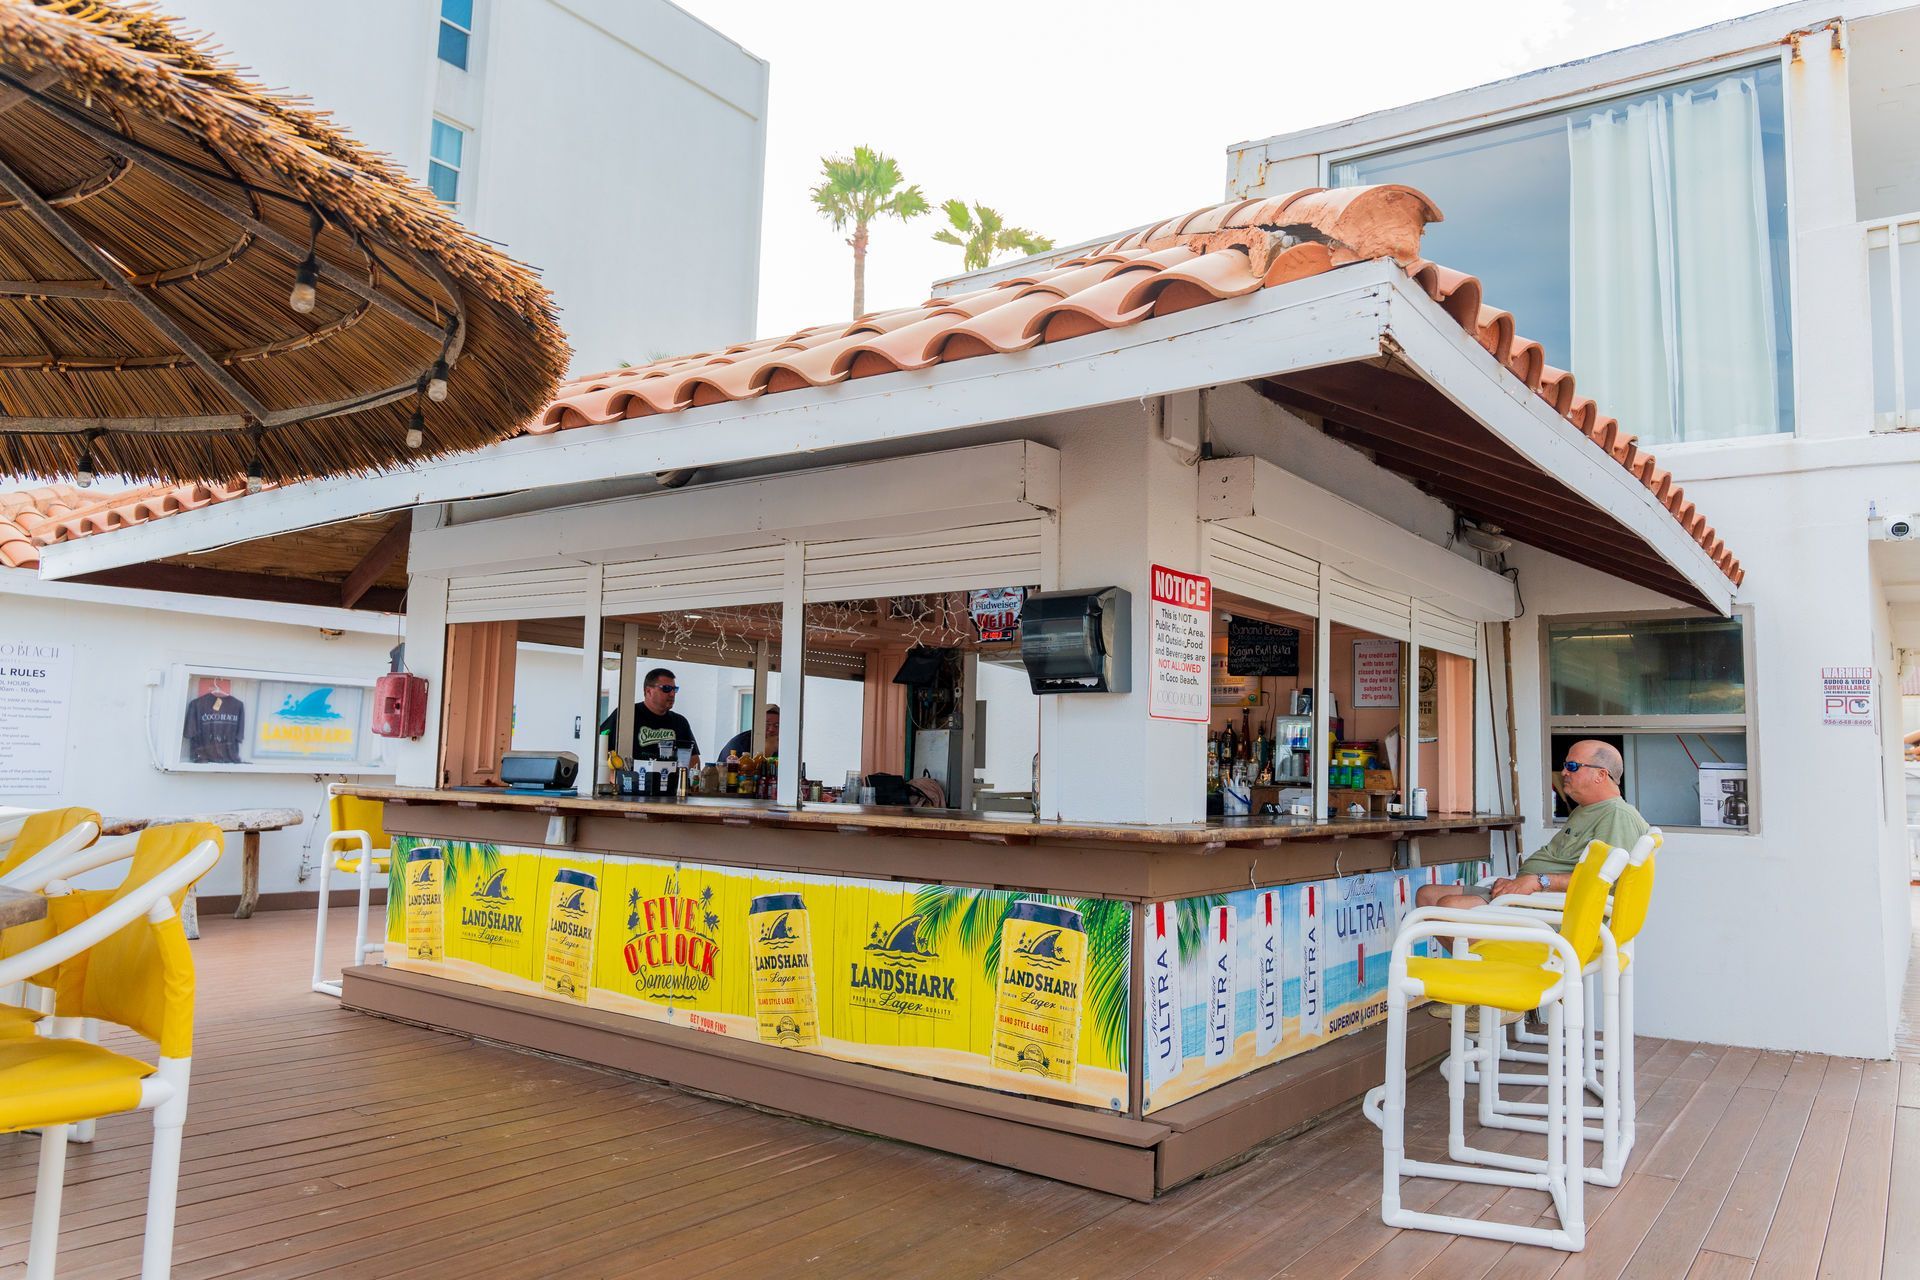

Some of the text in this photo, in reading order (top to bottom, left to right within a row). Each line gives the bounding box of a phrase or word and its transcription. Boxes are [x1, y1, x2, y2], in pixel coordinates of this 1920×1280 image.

[1155, 570, 1206, 607] NOTICE
[1162, 608, 1172, 620] This
[1173, 611, 1177, 621] is
[1178, 612, 1192, 623] NOT
[1155, 619, 1205, 638] Public Picnic Area.
[1264, 625, 1293, 636] Breeze
[17, 645, 59, 658] BEACH
[1165, 634, 1185, 647] Outside
[1186, 639, 1203, 650] Food
[1155, 646, 1205, 662] and Beverages are
[10, 668, 46, 678] RULES
[1158, 658, 1170, 669] NOT
[1171, 661, 1201, 674] ALLOWED
[1823, 667, 1871, 678] WARNING
[1160, 672, 1199, 685] in Coco Beach.
[1157, 689, 1202, 706] COCO BEACH
[201, 713, 238, 722] COCO BEACH
[261, 722, 353, 743] LANDSHARK
[664, 874, 680, 895] It's
[408, 894, 441, 906] LANDSHARK
[462, 907, 522, 933] LANDSHARK
[643, 896, 700, 934] FIVE
[1336, 901, 1386, 938] ULTRA
[478, 928, 503, 944] Lager
[550, 918, 592, 940] LANDSHARK
[560, 936, 579, 950] Lager
[624, 932, 720, 980] O'CLOCK
[755, 953, 809, 971] LANDSHARK
[635, 964, 710, 992] Somewhere
[769, 972, 796, 986] Lager
[1308, 927, 1316, 1016] ULTRA
[851, 963, 955, 1001] LANDSHARK
[1004, 966, 1077, 999] LANDSHARK
[1265, 936, 1274, 1030] ULTRA
[769, 998, 780, 1006] STYLE
[782, 997, 794, 1005] LAGER
[852, 992, 951, 1016] PREMIUM Lager QUALITY
[1021, 992, 1056, 1010] Lager
[1157, 949, 1171, 1059] ULTRA
[1215, 954, 1228, 1056] ULTRA
[1150, 976, 1159, 1047] Michelob
[1329, 1009, 1360, 1033] SUPERIOR
[1379, 1000, 1388, 1013] BE
[690, 1013, 699, 1025] GET
[701, 1016, 713, 1029] YOUR
[715, 1021, 726, 1034] FINS
[1014, 1018, 1030, 1030] STYLE
[1031, 1022, 1049, 1034] LAGER
